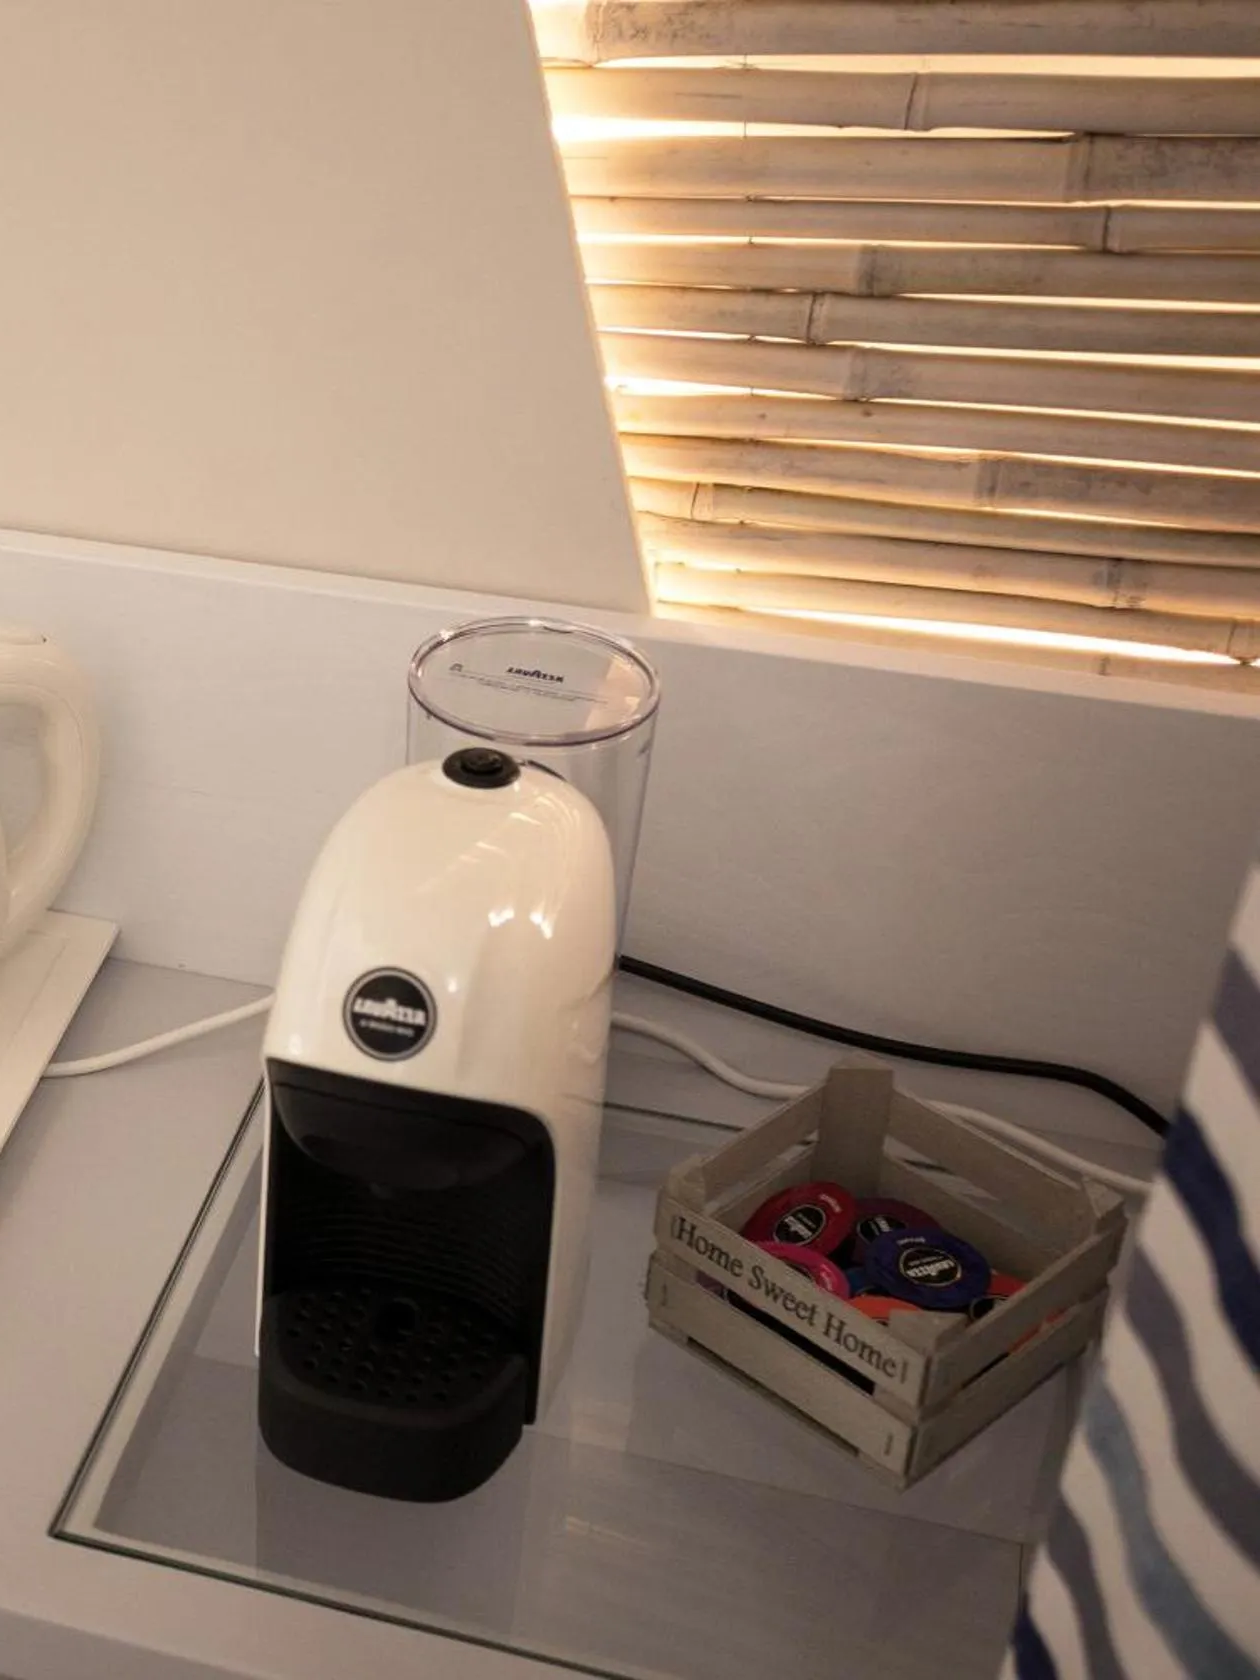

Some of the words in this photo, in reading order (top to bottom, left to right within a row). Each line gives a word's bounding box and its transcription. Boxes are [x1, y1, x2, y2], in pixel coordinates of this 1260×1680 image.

[676, 1216, 744, 1277] Home
[748, 1264, 817, 1327] Sweet
[822, 1311, 898, 1378] Home
